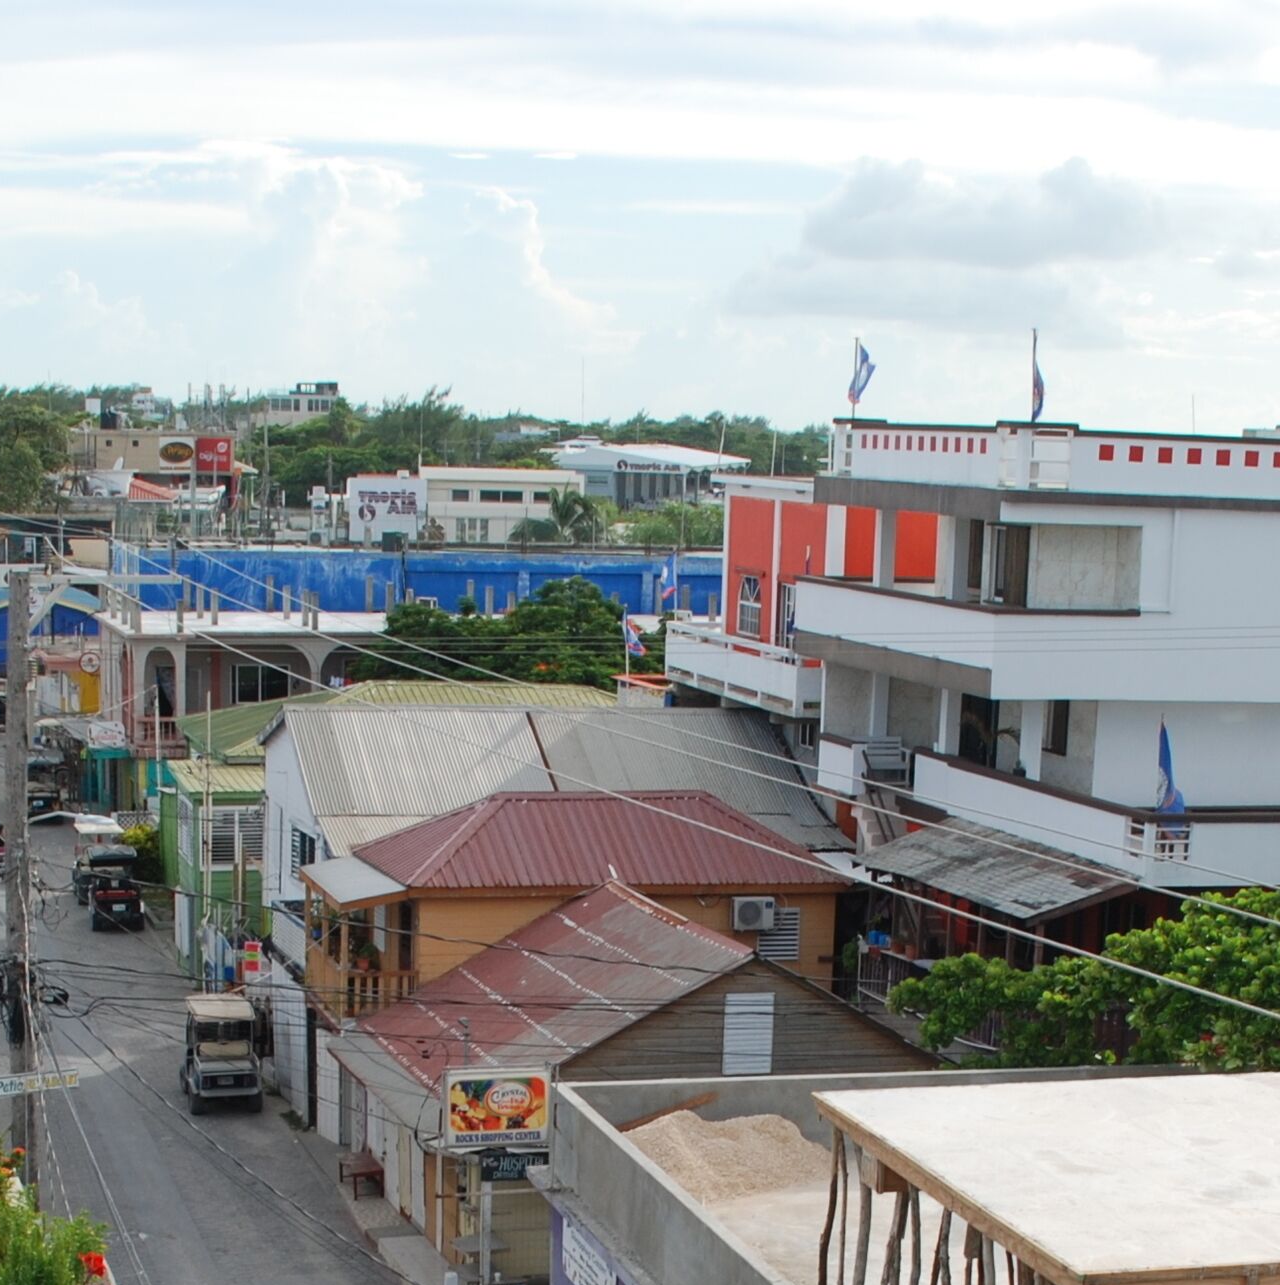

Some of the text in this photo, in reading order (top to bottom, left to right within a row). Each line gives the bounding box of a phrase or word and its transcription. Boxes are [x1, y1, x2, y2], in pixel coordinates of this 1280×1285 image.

[491, 1088, 528, 1104] CRYSTAL
[455, 1131, 541, 1143] ROCK'S SHOPPING CENTER
